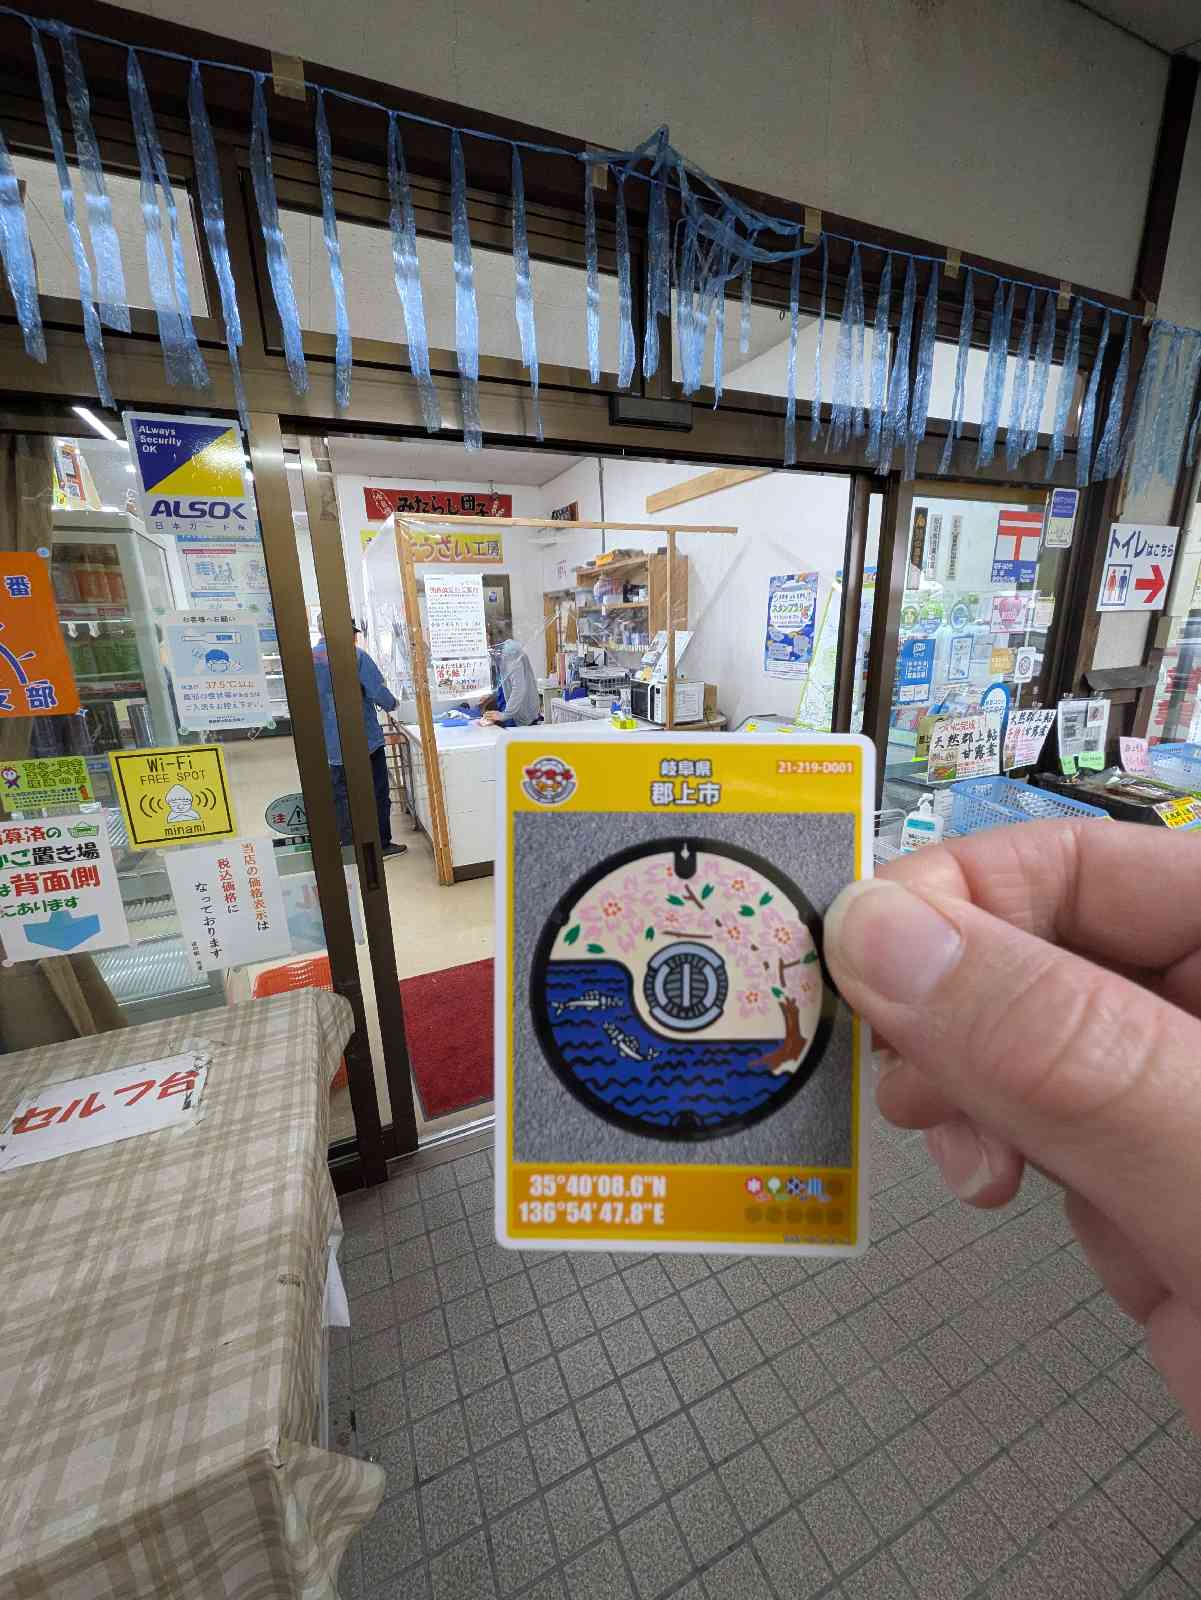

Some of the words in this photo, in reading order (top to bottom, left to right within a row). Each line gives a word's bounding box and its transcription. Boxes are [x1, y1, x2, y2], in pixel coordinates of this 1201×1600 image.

[140, 434, 182, 447] Security
[142, 444, 158, 454] OK
[150, 499, 248, 521] ALSOK
[1109, 528, 1174, 559] トイレはこちら
[146, 755, 193, 773] Wi-Fi
[660, 758, 713, 778] 岐阜県
[140, 773, 169, 785] FREE
[176, 769, 206, 782] SPOT
[650, 779, 722, 807] 郡上市
[0, 826, 62, 845] 算済の
[164, 820, 206, 837] minami
[216, 857, 240, 914] 税込価格に
[241, 842, 272, 932] 当店の価格表示は
[194, 881, 223, 959] なっております
[12, 1070, 200, 1135] セルフ台
